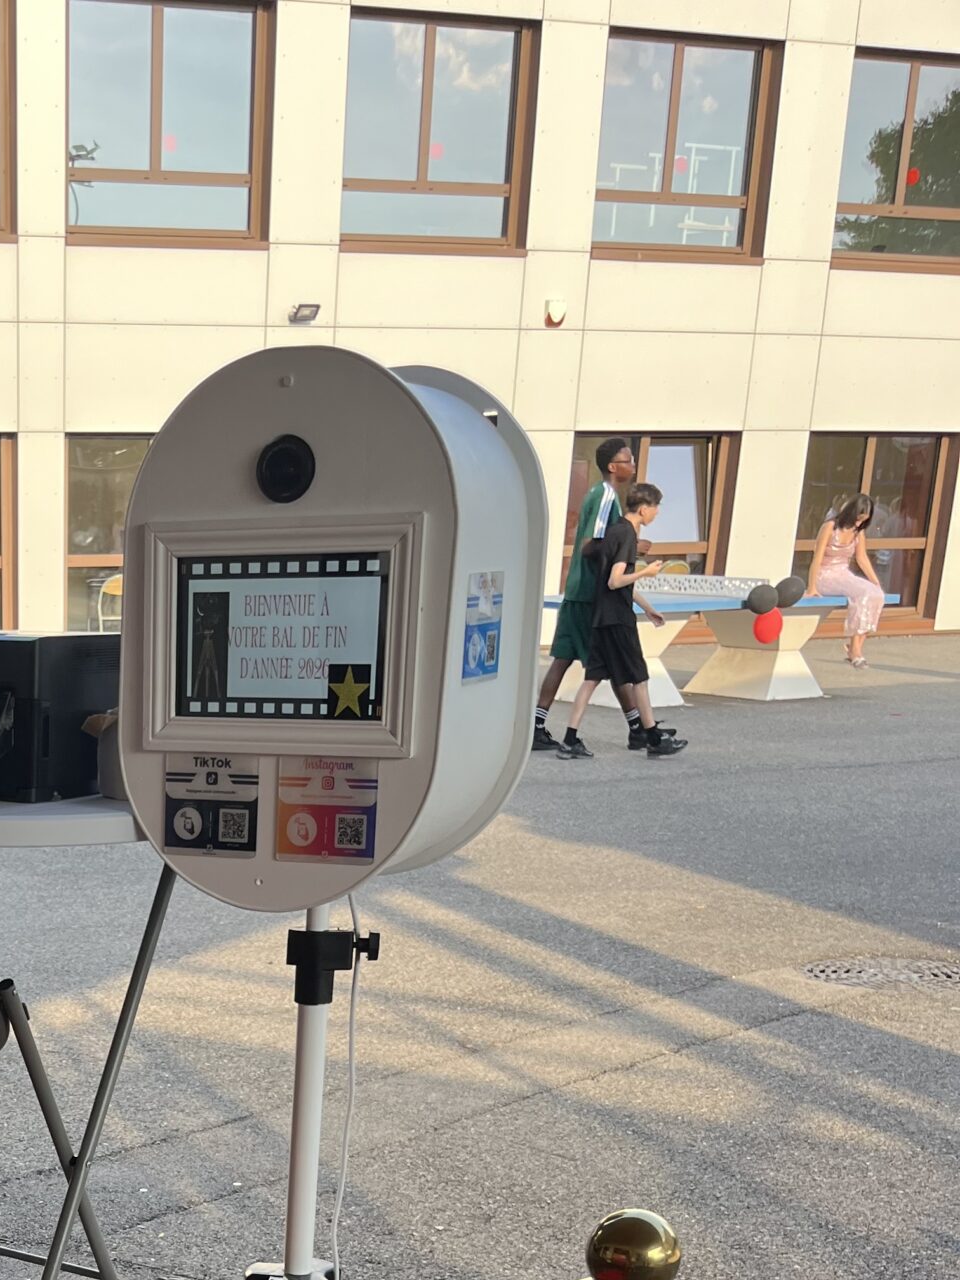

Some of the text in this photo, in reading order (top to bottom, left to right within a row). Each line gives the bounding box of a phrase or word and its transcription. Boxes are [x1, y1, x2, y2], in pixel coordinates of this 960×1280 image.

[244, 591, 330, 617] BIENVENUE À
[227, 625, 348, 649] VOTRE BAL DE FIN
[240, 656, 293, 680] D'ANNÉE
[193, 756, 232, 769] TikTok
[302, 757, 355, 775] Instagram
